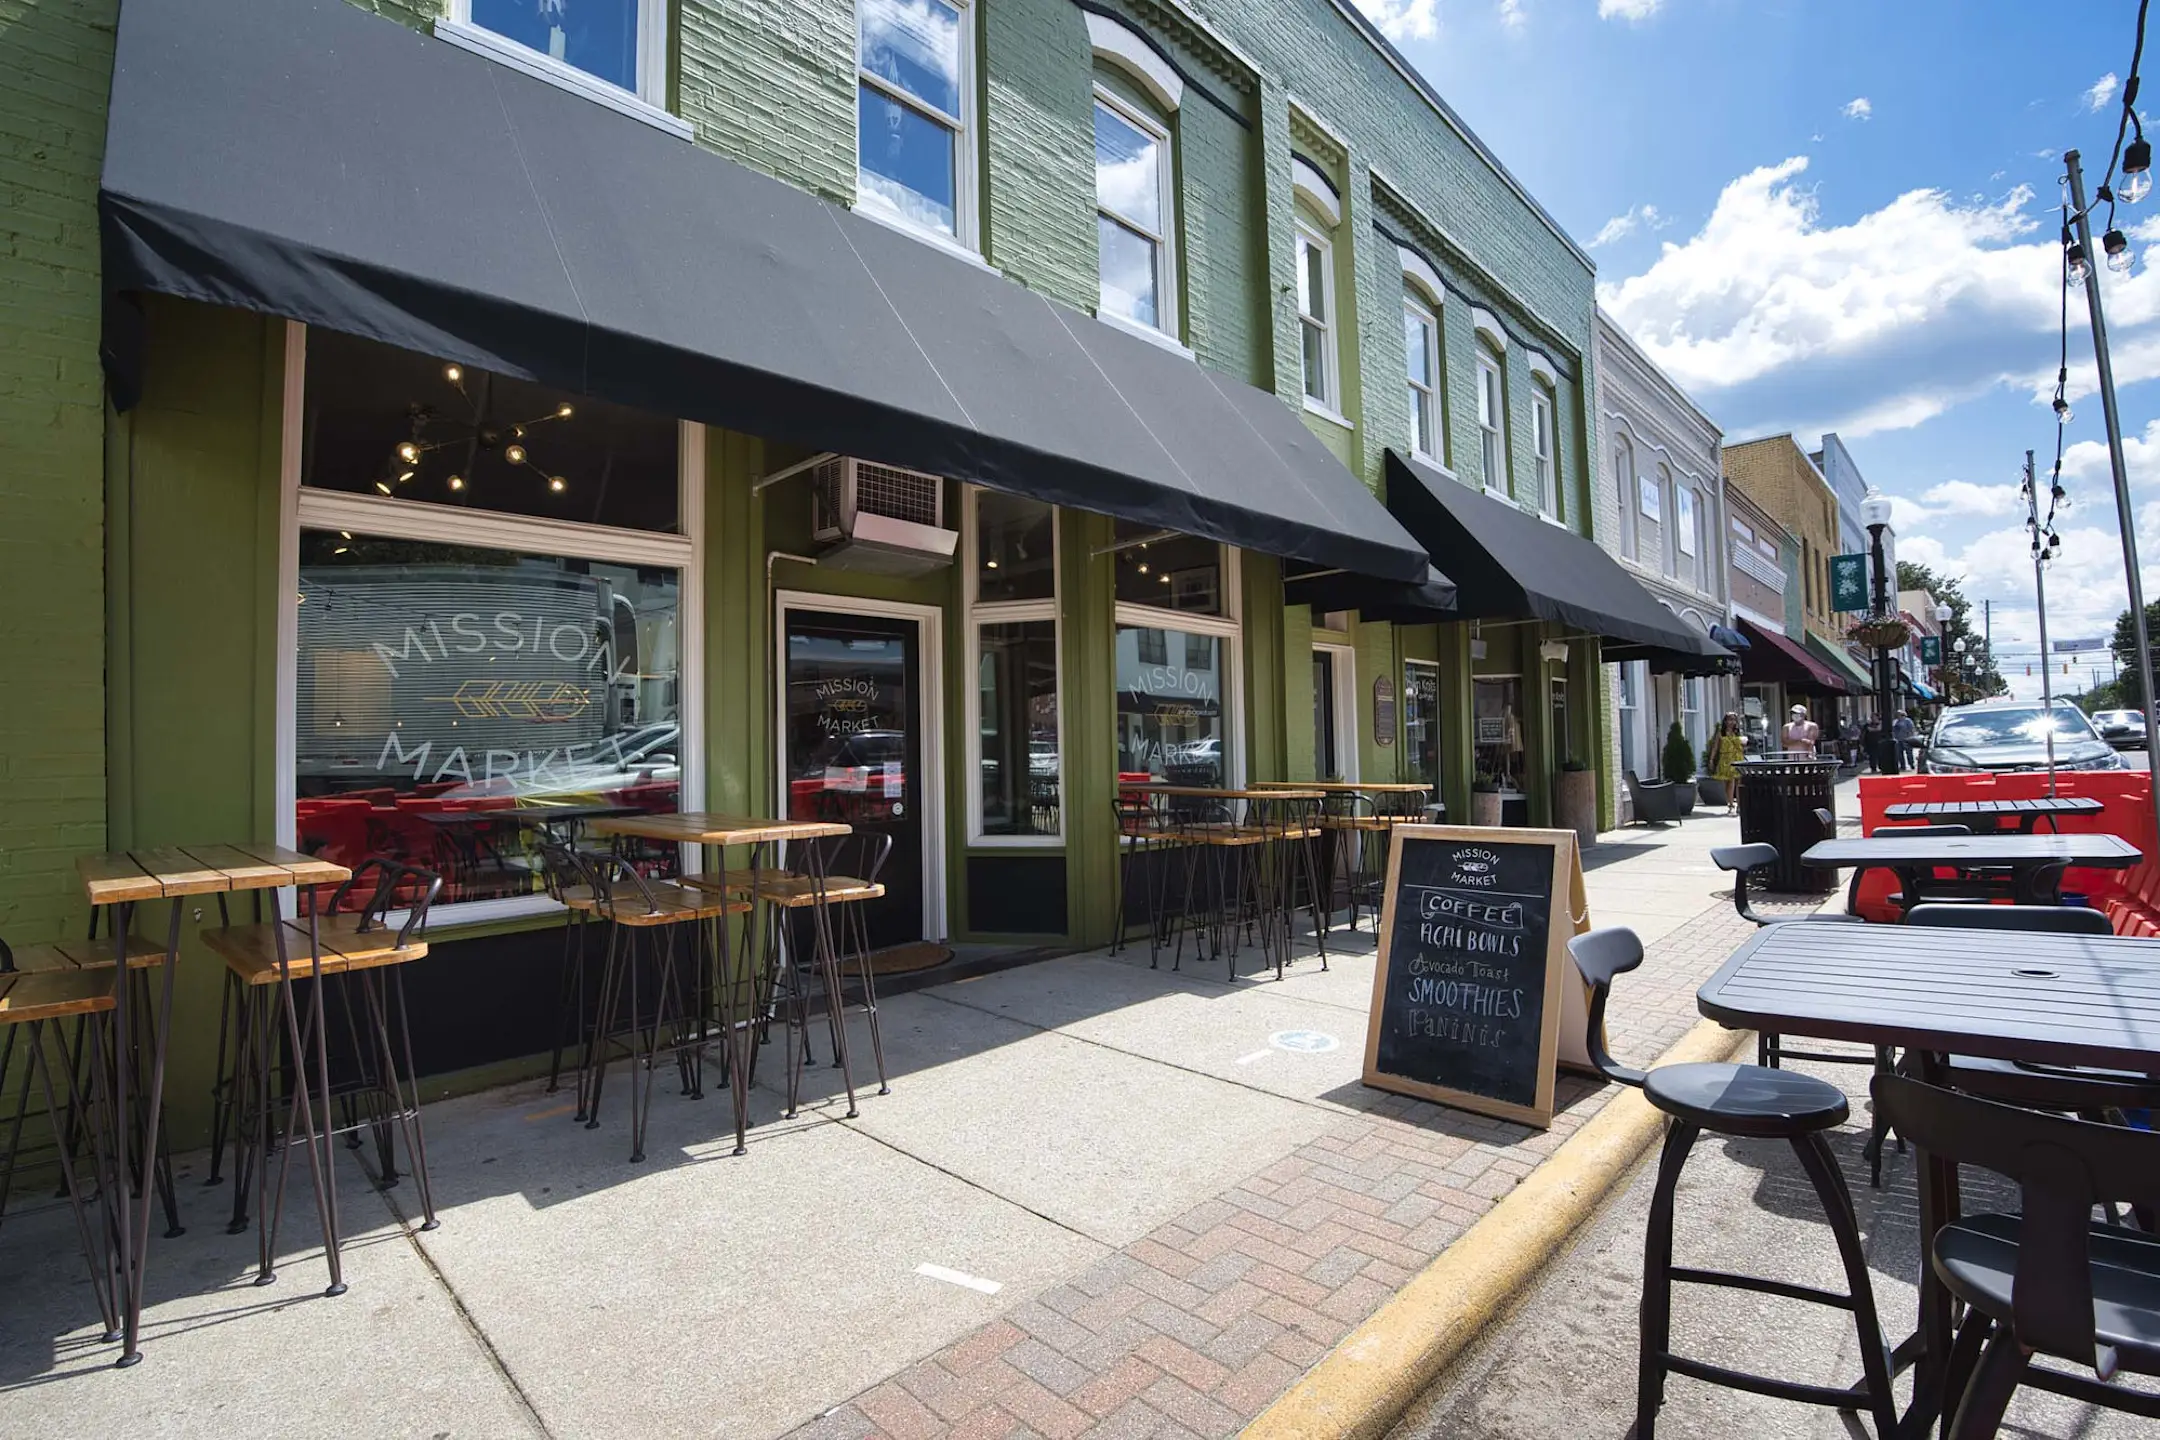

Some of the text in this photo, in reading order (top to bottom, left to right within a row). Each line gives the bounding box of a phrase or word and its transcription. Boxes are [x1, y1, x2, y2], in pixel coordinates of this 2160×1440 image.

[372, 612, 631, 685] MISSION
[816, 677, 879, 701] MISSION
[1129, 666, 1212, 708] MISSION
[817, 715, 879, 733] MARKET
[376, 731, 627, 788] MARKET
[1131, 734, 1211, 765] MARKE
[1452, 848, 1500, 865] MISSION
[1451, 871, 1497, 886] MARKET
[1429, 896, 1514, 924] COFFEE
[1467, 930, 1521, 957] BOWLS
[1408, 951, 1511, 982] Avocado Toast
[1408, 977, 1524, 1019] SMOOTHIES
